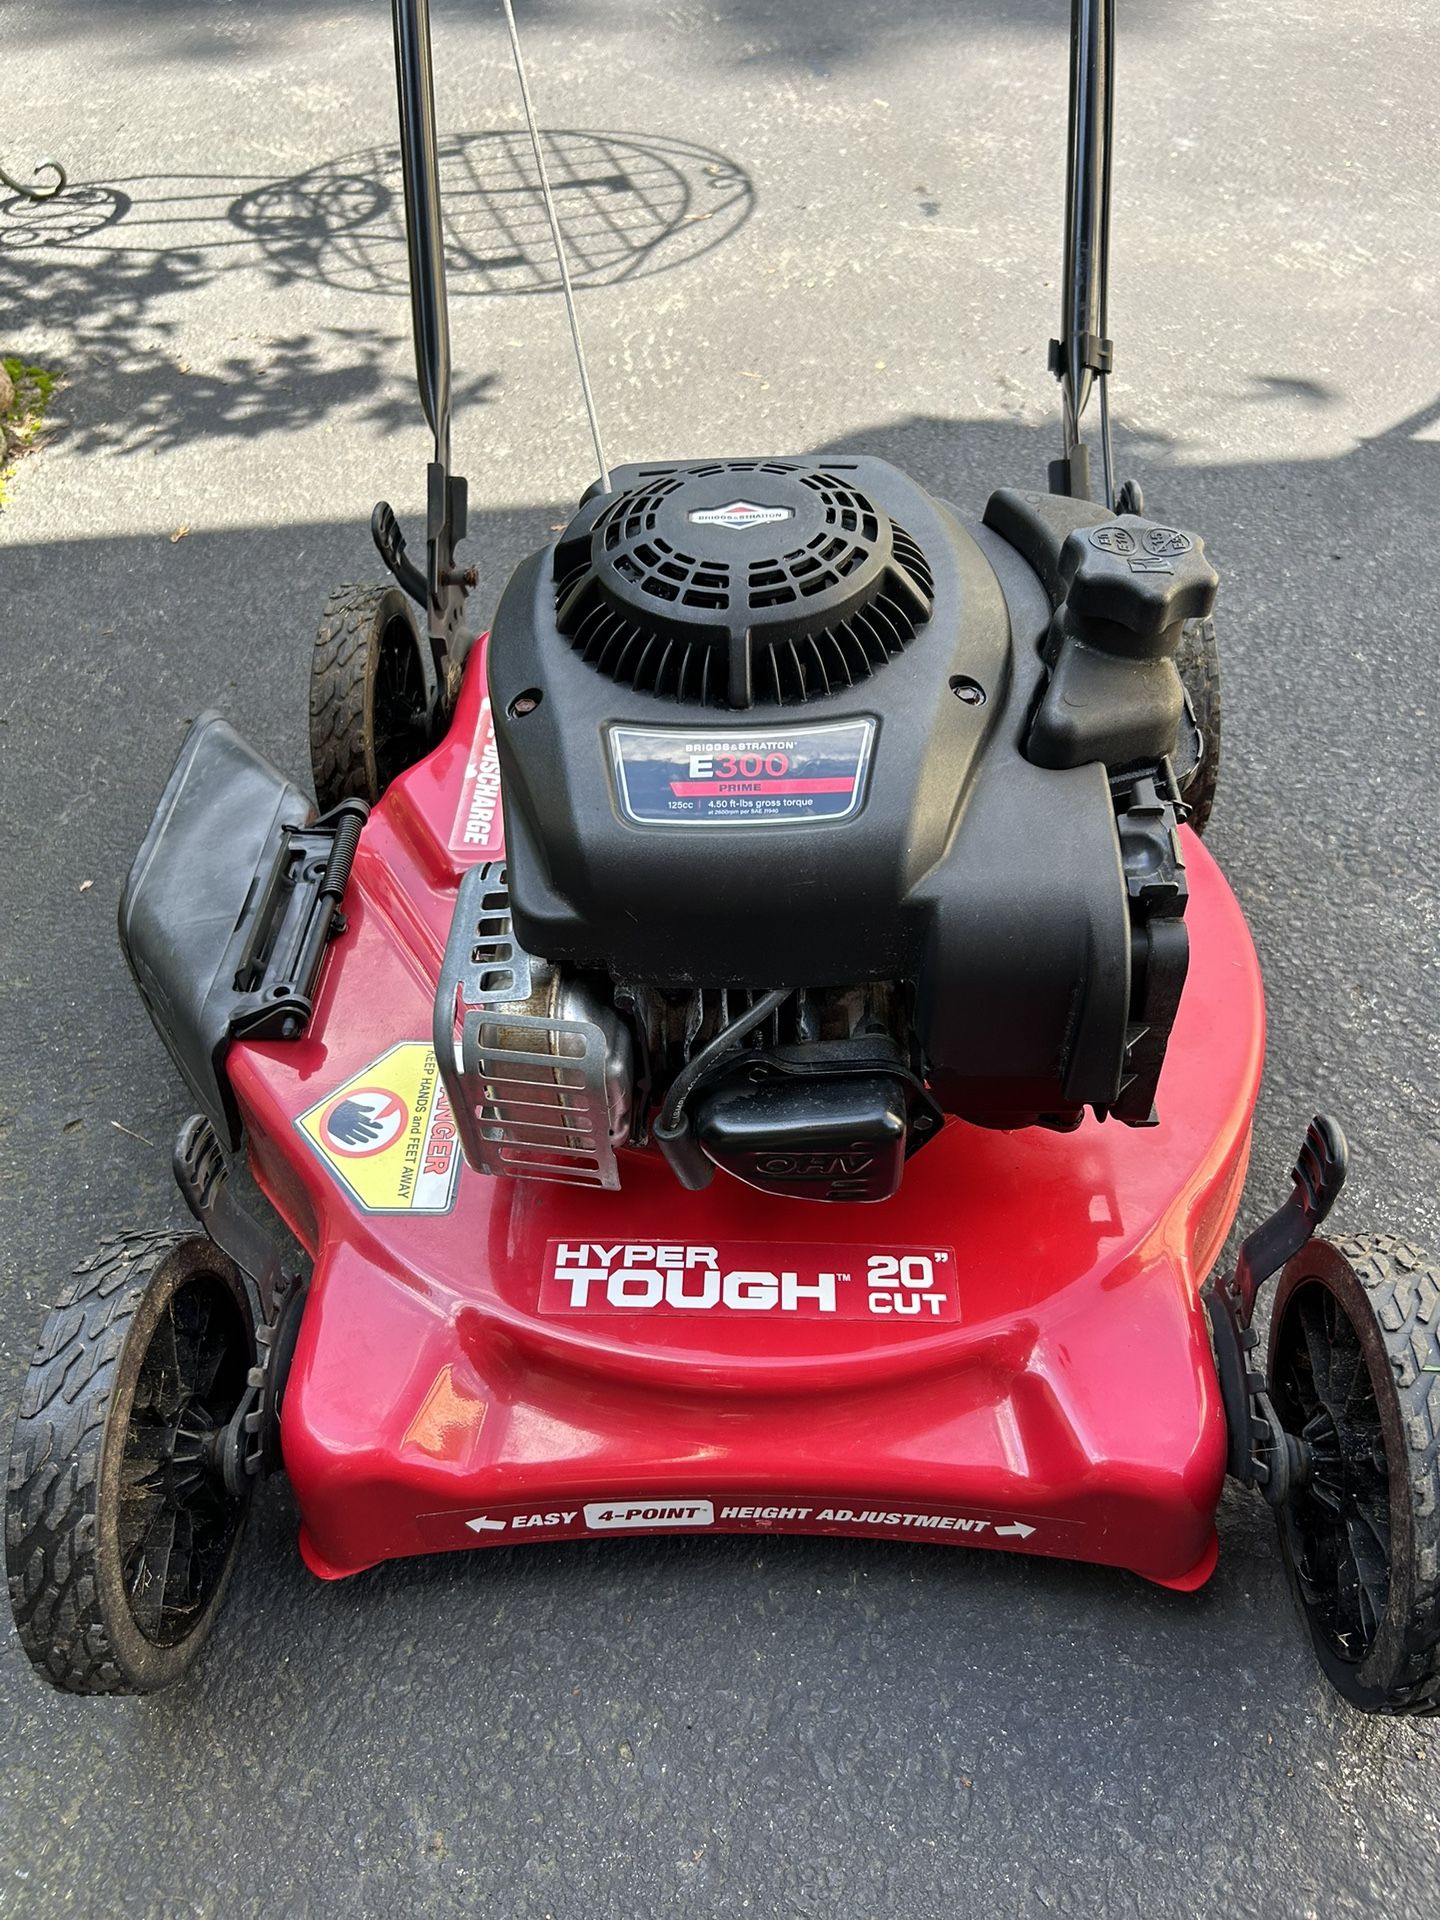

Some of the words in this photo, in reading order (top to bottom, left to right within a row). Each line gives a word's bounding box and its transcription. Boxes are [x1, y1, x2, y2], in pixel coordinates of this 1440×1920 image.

[689, 753, 790, 779] E300
[718, 783, 763, 793] PRIME
[667, 801, 694, 809] 125cc
[708, 800, 728, 808] 4.50
[730, 799, 754, 808] ft-lbs
[756, 799, 781, 809] gross
[783, 798, 814, 808] torque
[415, 1077, 434, 1114] HANDS
[410, 1115, 423, 1135] and
[404, 1137, 421, 1164] FEET
[756, 1157, 874, 1175] OHV
[397, 1166, 415, 1200] AWAY
[556, 1244, 719, 1269] HYPER
[868, 1292, 948, 1315] CUT
[511, 1511, 578, 1529] EASY
[719, 1506, 813, 1520] HEIGHT
[815, 1508, 991, 1533] ADJUSTMENT
